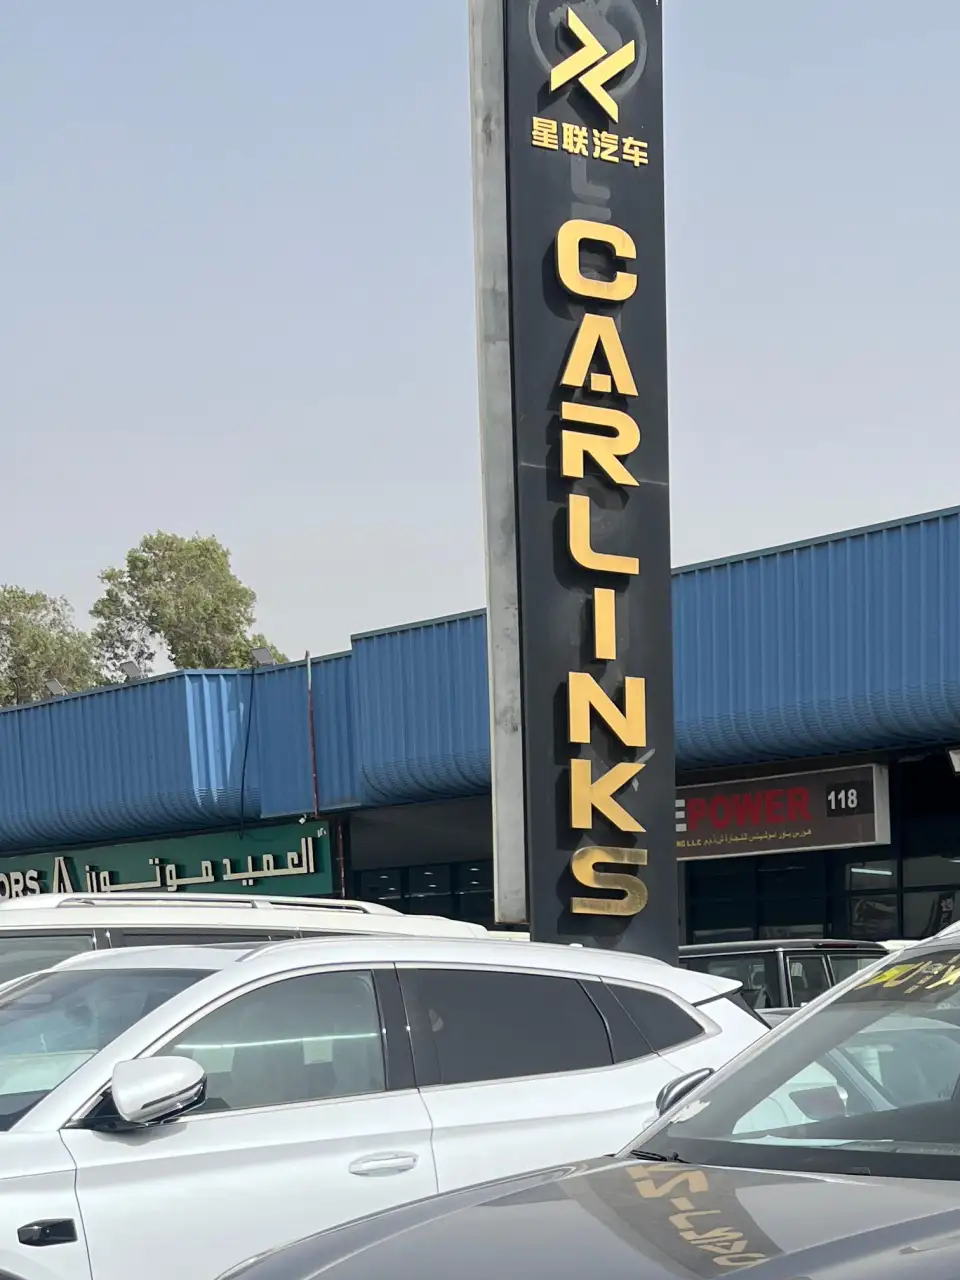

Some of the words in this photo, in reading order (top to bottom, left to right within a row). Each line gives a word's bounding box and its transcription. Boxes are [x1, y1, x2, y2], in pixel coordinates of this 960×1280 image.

[532, 116, 649, 168] 星联汽车
[556, 218, 649, 917] CARLINKS
[687, 786, 813, 831] POWER
[827, 788, 858, 810] 118
[223, 836, 314, 886] العميد
